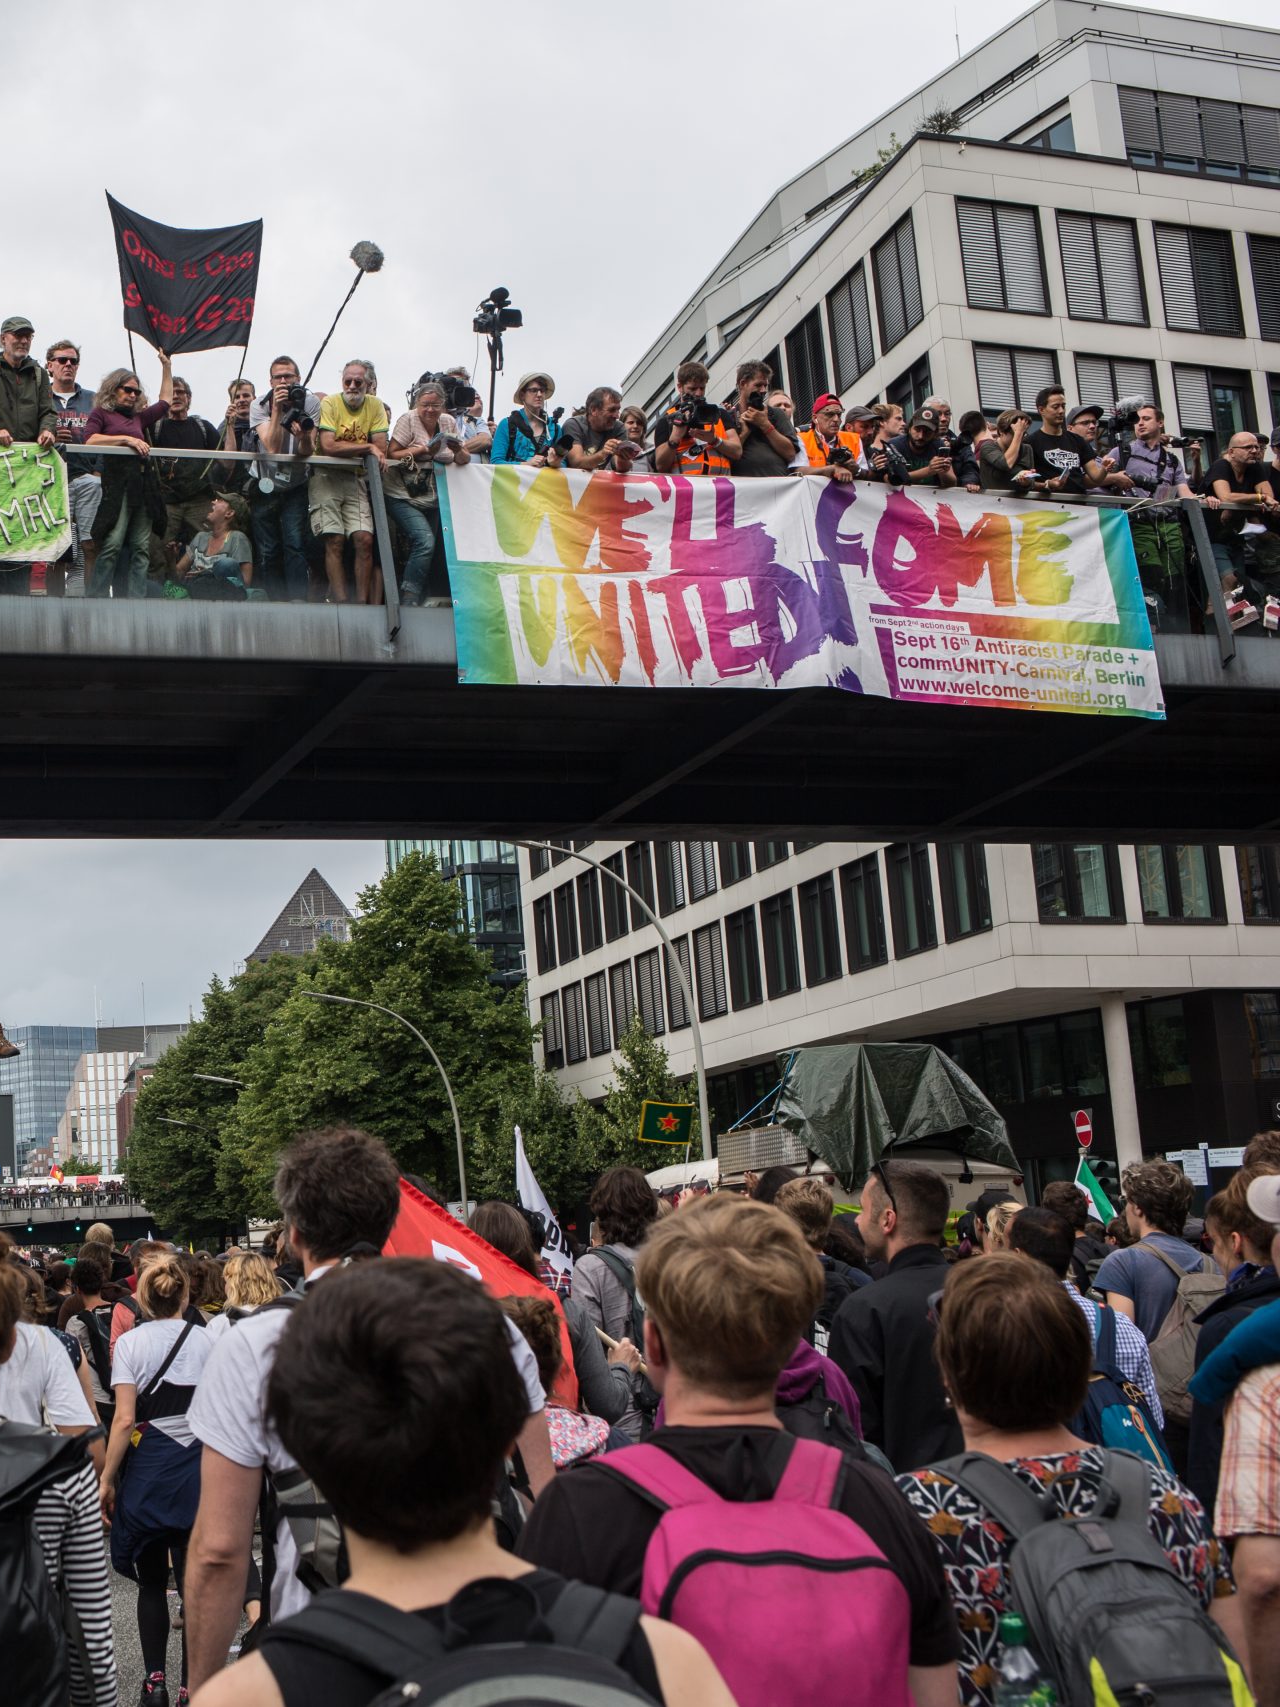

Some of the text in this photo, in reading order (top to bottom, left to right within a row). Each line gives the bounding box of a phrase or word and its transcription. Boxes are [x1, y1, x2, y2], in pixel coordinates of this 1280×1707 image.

[122, 229, 177, 280] Oma
[204, 251, 255, 277] Opa
[124, 282, 256, 335] ggen G20
[517, 562, 826, 690] UNITED
[868, 615, 887, 625] from
[887, 617, 907, 628] Sept
[920, 621, 945, 630] action
[945, 624, 965, 633] days
[894, 630, 1140, 665] Sept 16th Antiracist Parade +
[897, 654, 1146, 688] commUNITY-Carnival, Berlin
[900, 677, 1127, 709] www.welcome-united.org
